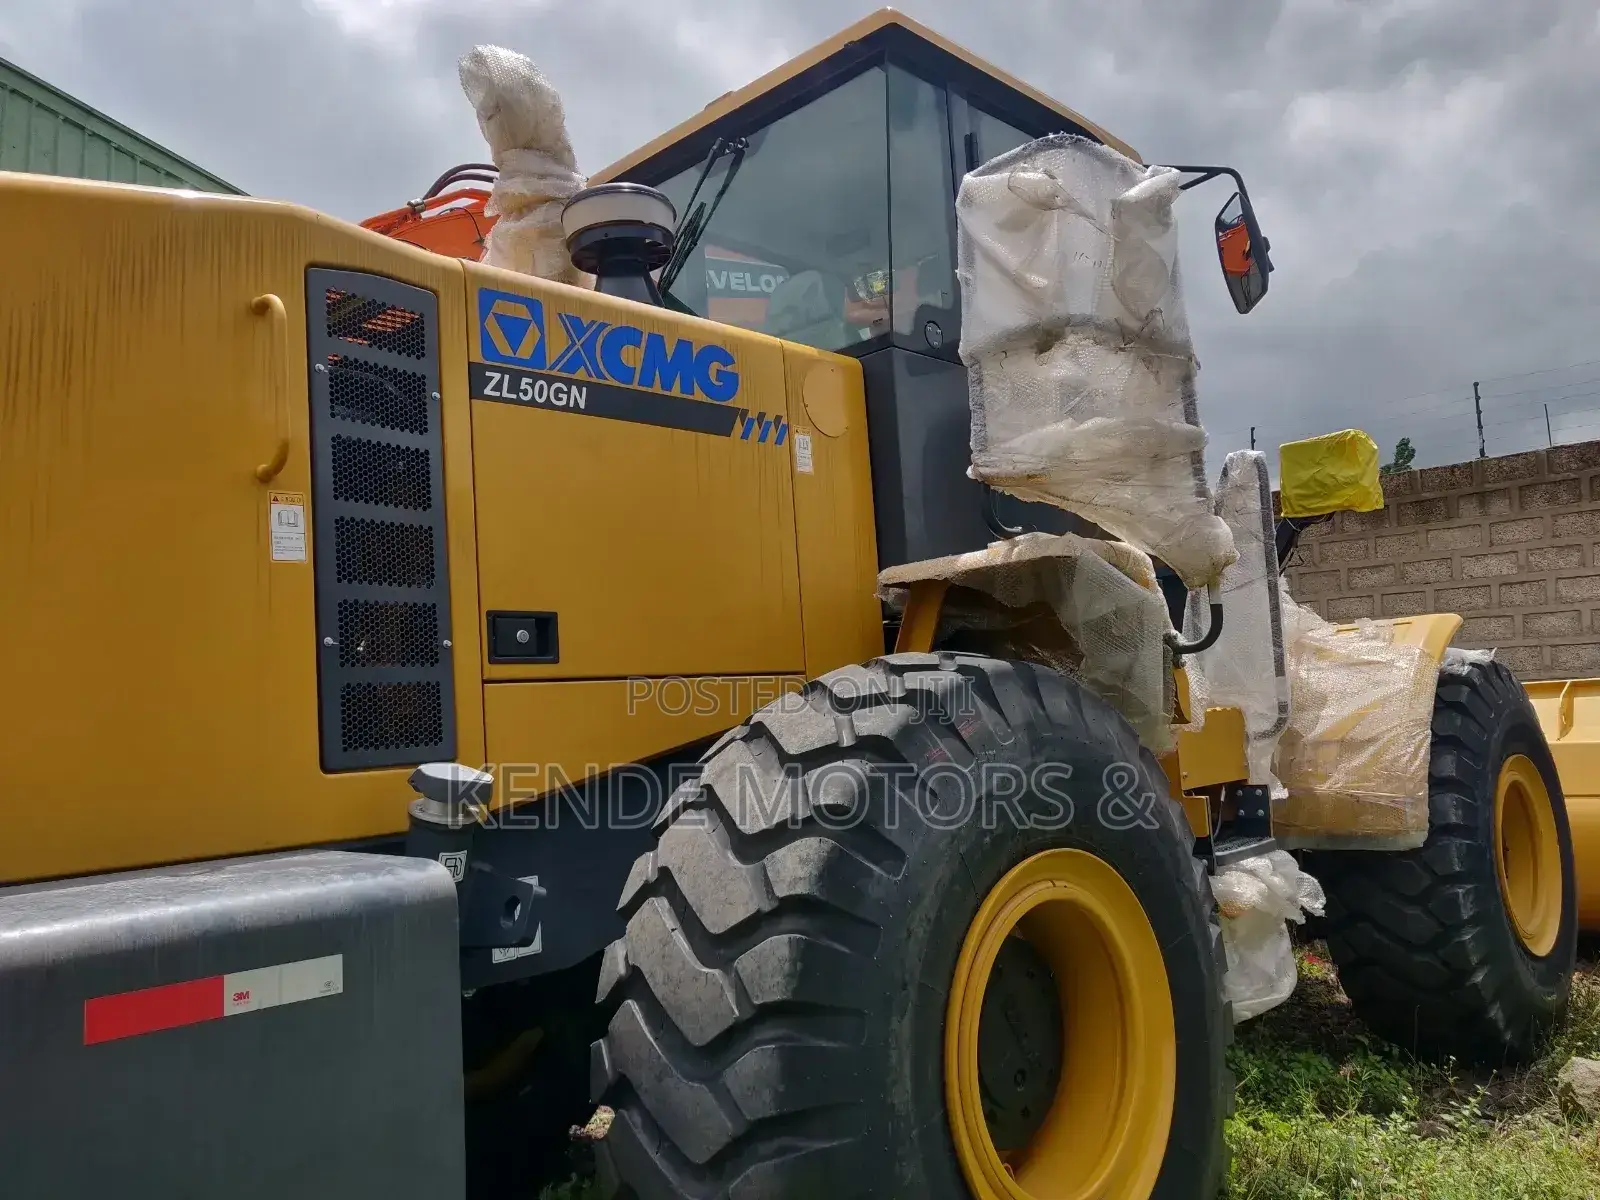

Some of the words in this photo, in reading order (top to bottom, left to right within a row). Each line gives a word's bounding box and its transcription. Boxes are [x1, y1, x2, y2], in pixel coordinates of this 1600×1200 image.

[706, 269, 784, 293] VELO
[547, 312, 739, 402] XCMG
[483, 371, 587, 409] ZL50GN
[232, 990, 250, 1001] 3M
